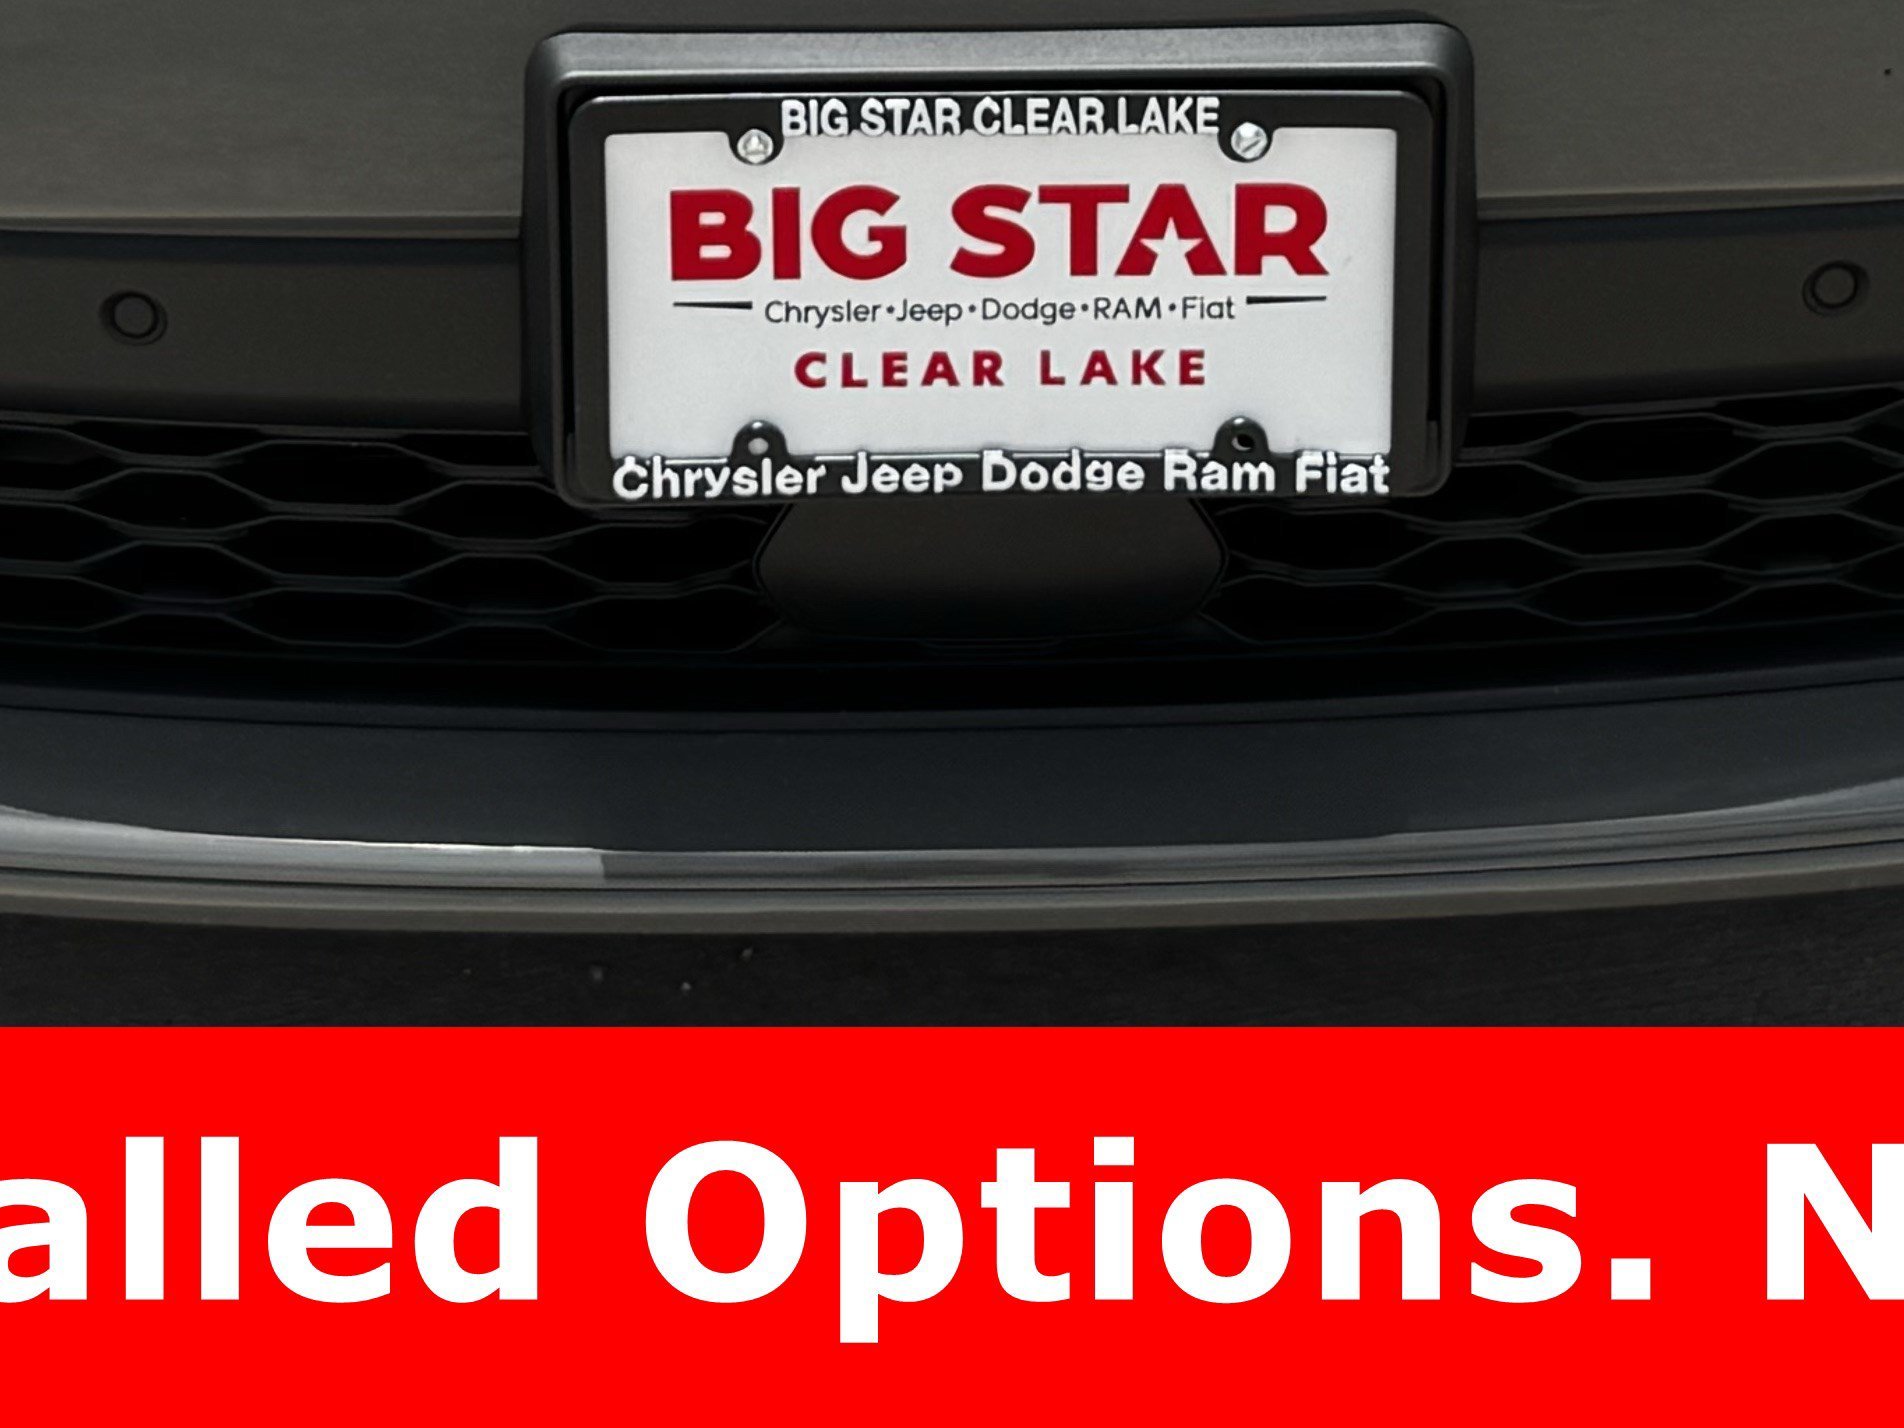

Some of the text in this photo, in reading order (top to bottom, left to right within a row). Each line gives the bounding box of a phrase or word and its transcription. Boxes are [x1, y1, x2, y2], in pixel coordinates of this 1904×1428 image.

[781, 96, 1220, 137] BIG STAR CLEAR LAKE
[670, 183, 1329, 281] BIG STAR
[764, 296, 1236, 328] Chrysler Jeep Dodge RAM Fiat
[794, 349, 1206, 388] CLEAR LAKE
[612, 447, 1390, 500] Chrysler Jeep Dodge Ram Fiat
